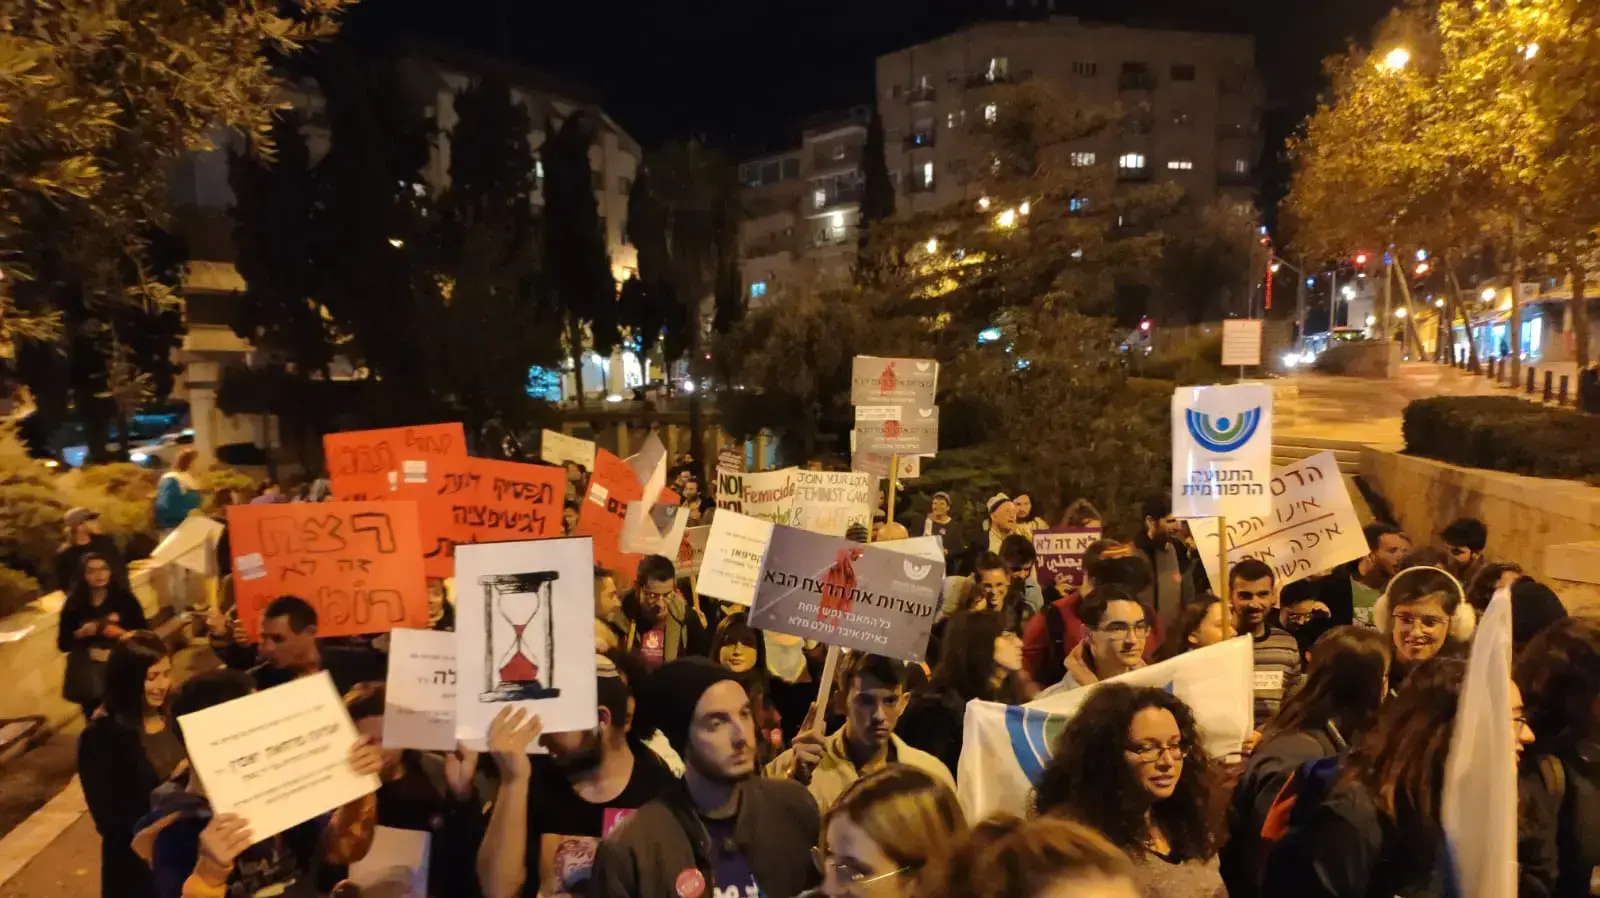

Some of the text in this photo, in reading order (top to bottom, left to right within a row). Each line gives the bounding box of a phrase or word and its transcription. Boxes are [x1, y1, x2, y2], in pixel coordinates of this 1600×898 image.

[797, 472, 823, 485] JOIN
[1191, 469, 1253, 483] התנועה
[1269, 466, 1323, 496] הדם
[492, 478, 553, 505] תפסיק
[719, 473, 796, 504] NO! Femicide
[1182, 483, 1264, 496] הרפורמית
[1276, 496, 1320, 523] אינו
[259, 512, 397, 557] רצח
[1036, 536, 1050, 550] לא
[1055, 538, 1072, 549] זה
[1290, 522, 1344, 552] איפה
[279, 558, 372, 580] זה לא
[764, 569, 798, 588] הבא
[802, 577, 845, 597] הרצח
[850, 589, 876, 606] את
[798, 601, 891, 630] כל המאבד נפש אחת
[876, 594, 932, 617] עוצרות
[788, 615, 809, 628] מלא
